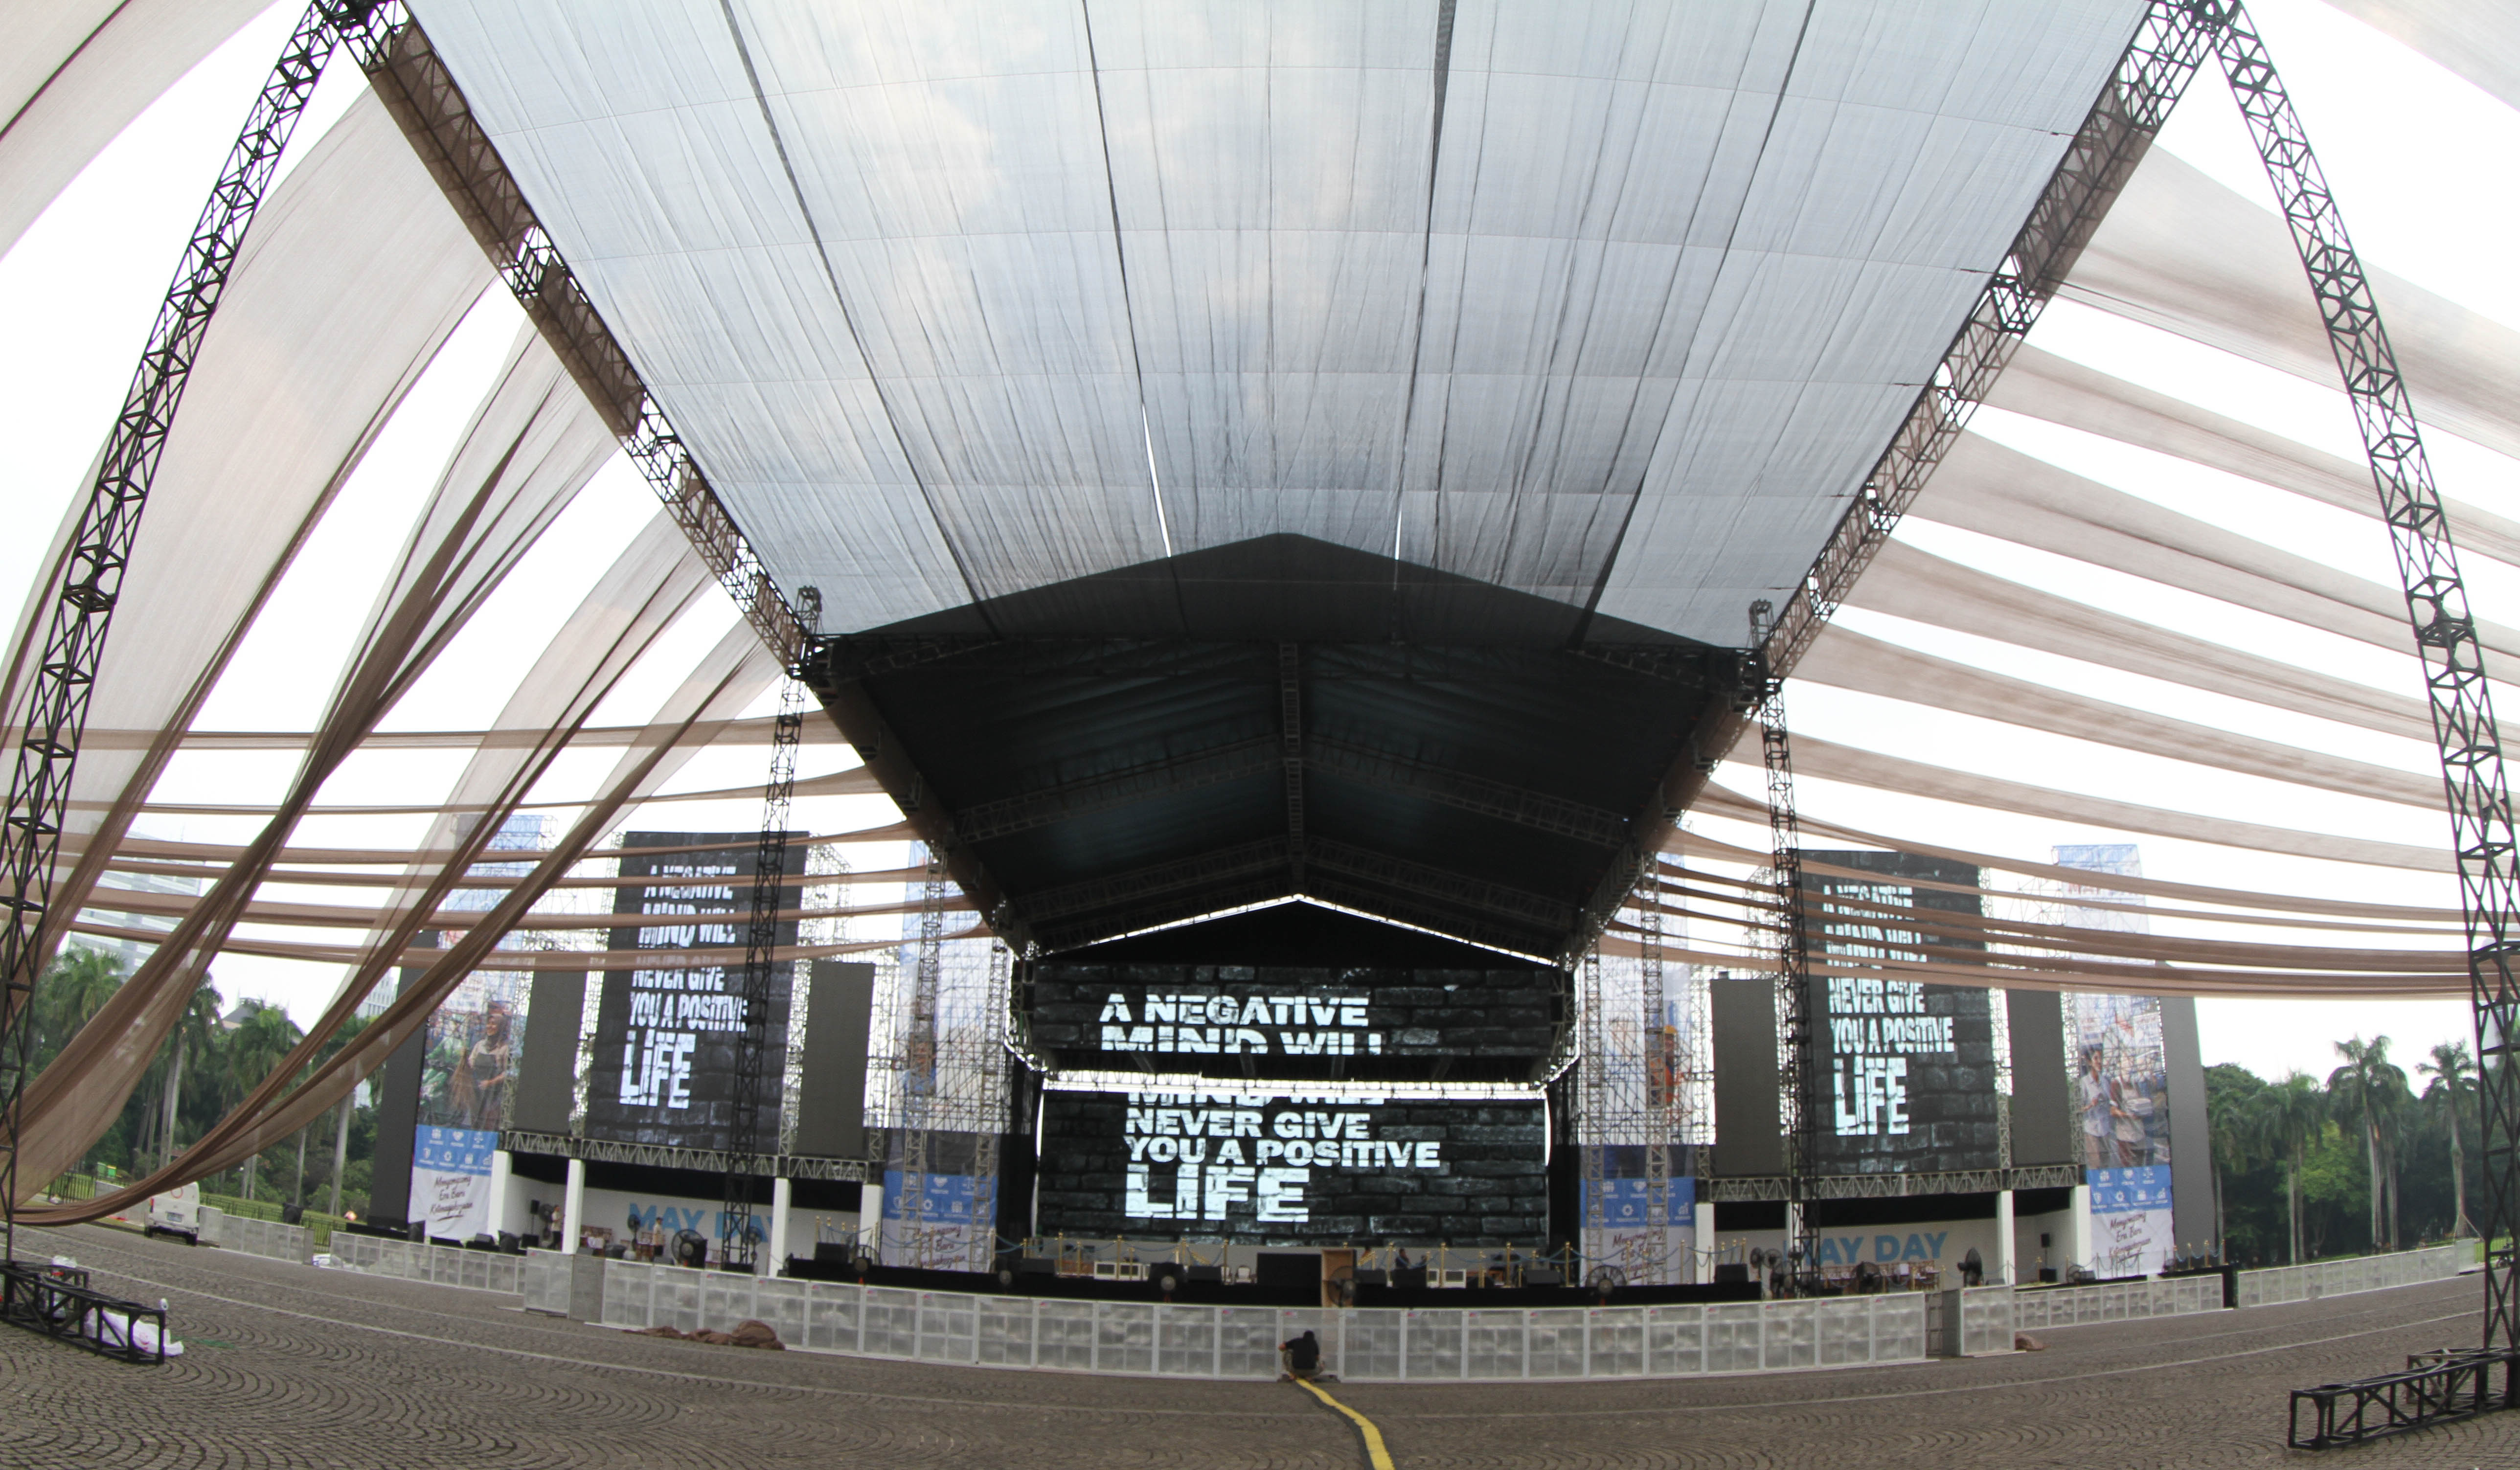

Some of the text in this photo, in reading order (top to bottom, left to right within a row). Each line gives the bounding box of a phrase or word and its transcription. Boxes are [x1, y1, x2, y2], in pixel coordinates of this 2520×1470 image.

[630, 991, 662, 1027] YOU
[660, 994, 674, 1028] A
[1099, 993, 1369, 1026] A NEGATIVE
[1828, 977, 1926, 1014] NEVER GIVE
[1101, 1025, 1269, 1054] MIND
[1829, 1016, 1955, 1054] YOU A POSITIVE
[619, 1028, 697, 1109] LIFE
[1833, 1055, 1910, 1136] LIFE
[1125, 1107, 1370, 1139] NEVER GIVE
[1123, 1134, 1441, 1168] YOU A POSITIVE
[1125, 1162, 1310, 1223] LIFE
[630, 1202, 705, 1235] MAY
[1874, 1231, 1948, 1262] DAY
